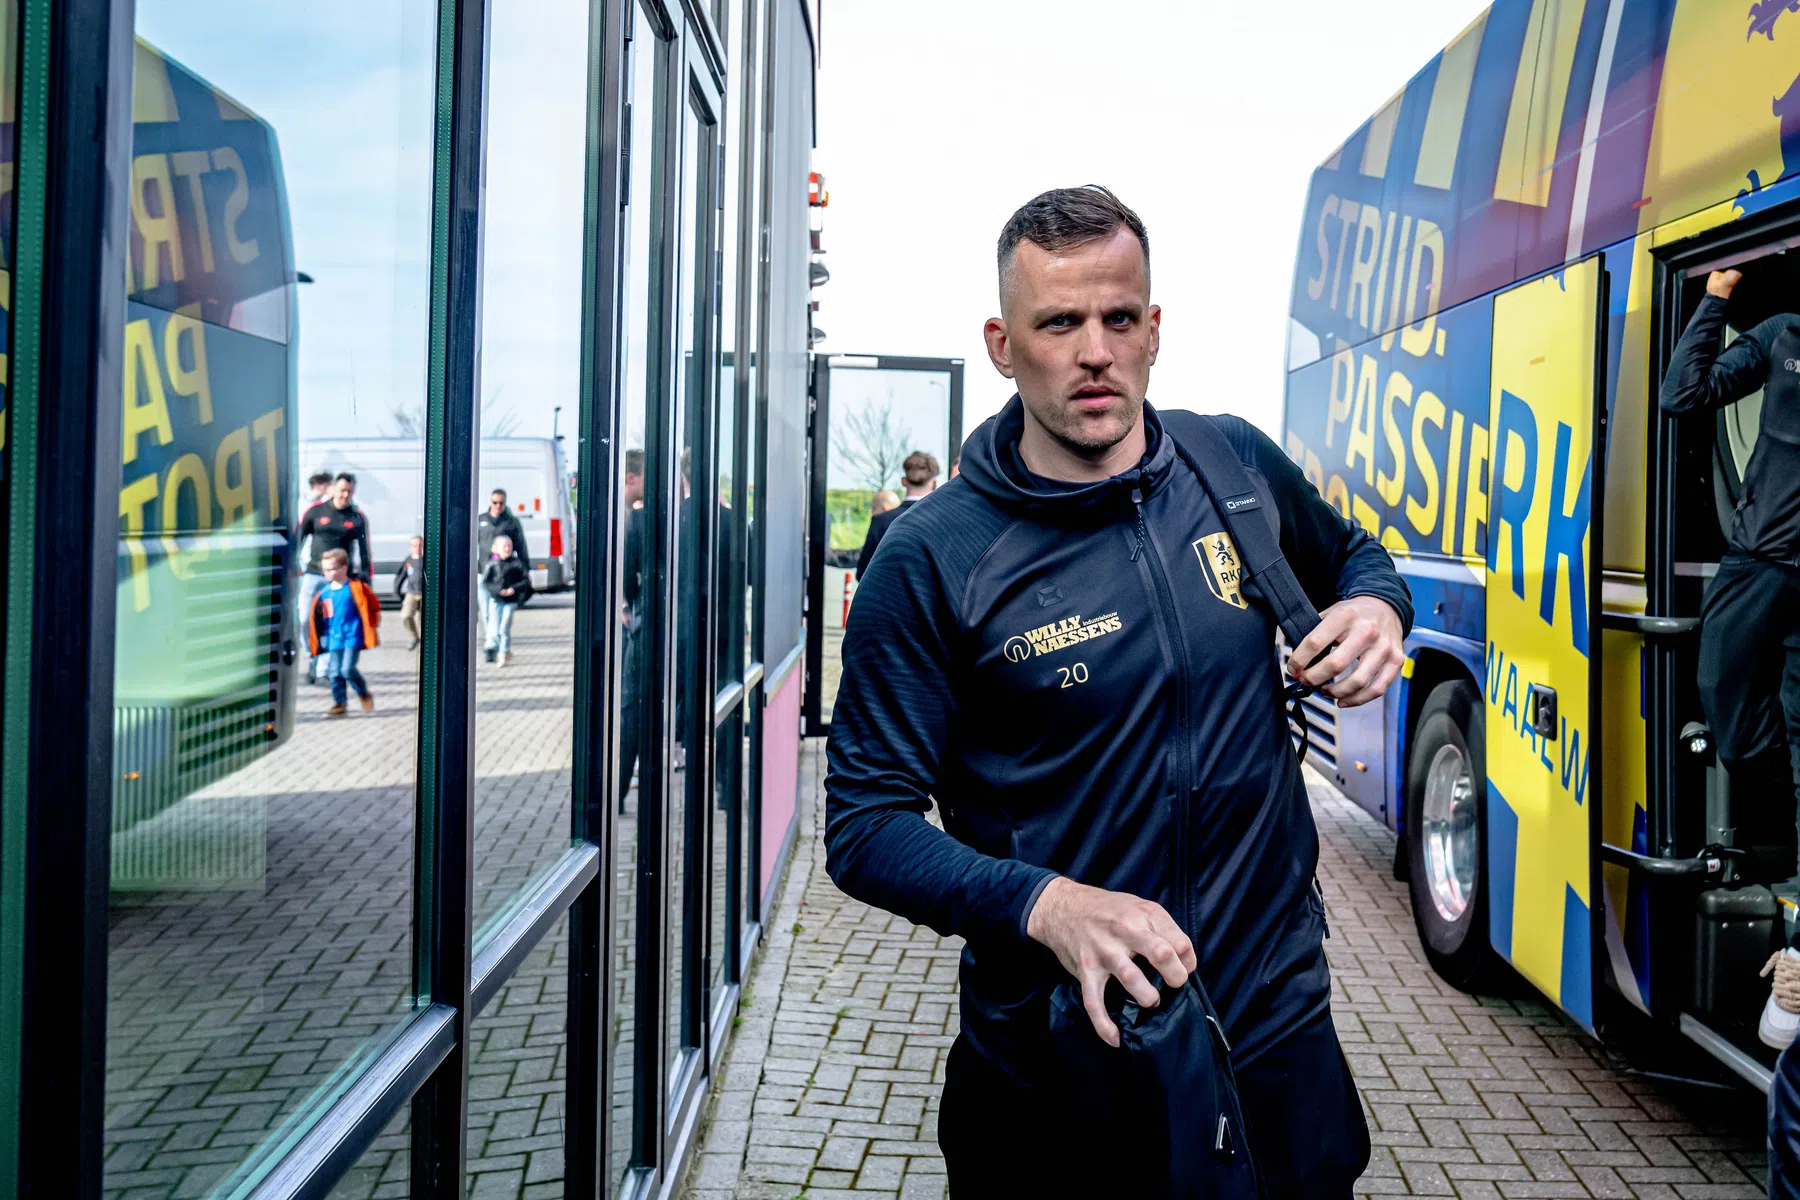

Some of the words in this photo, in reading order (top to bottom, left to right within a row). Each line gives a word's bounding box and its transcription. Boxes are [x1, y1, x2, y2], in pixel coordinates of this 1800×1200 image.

[1024, 615, 1081, 644] WILLY
[1033, 616, 1123, 657] NAESSENS
[1056, 662, 1089, 689] 20
